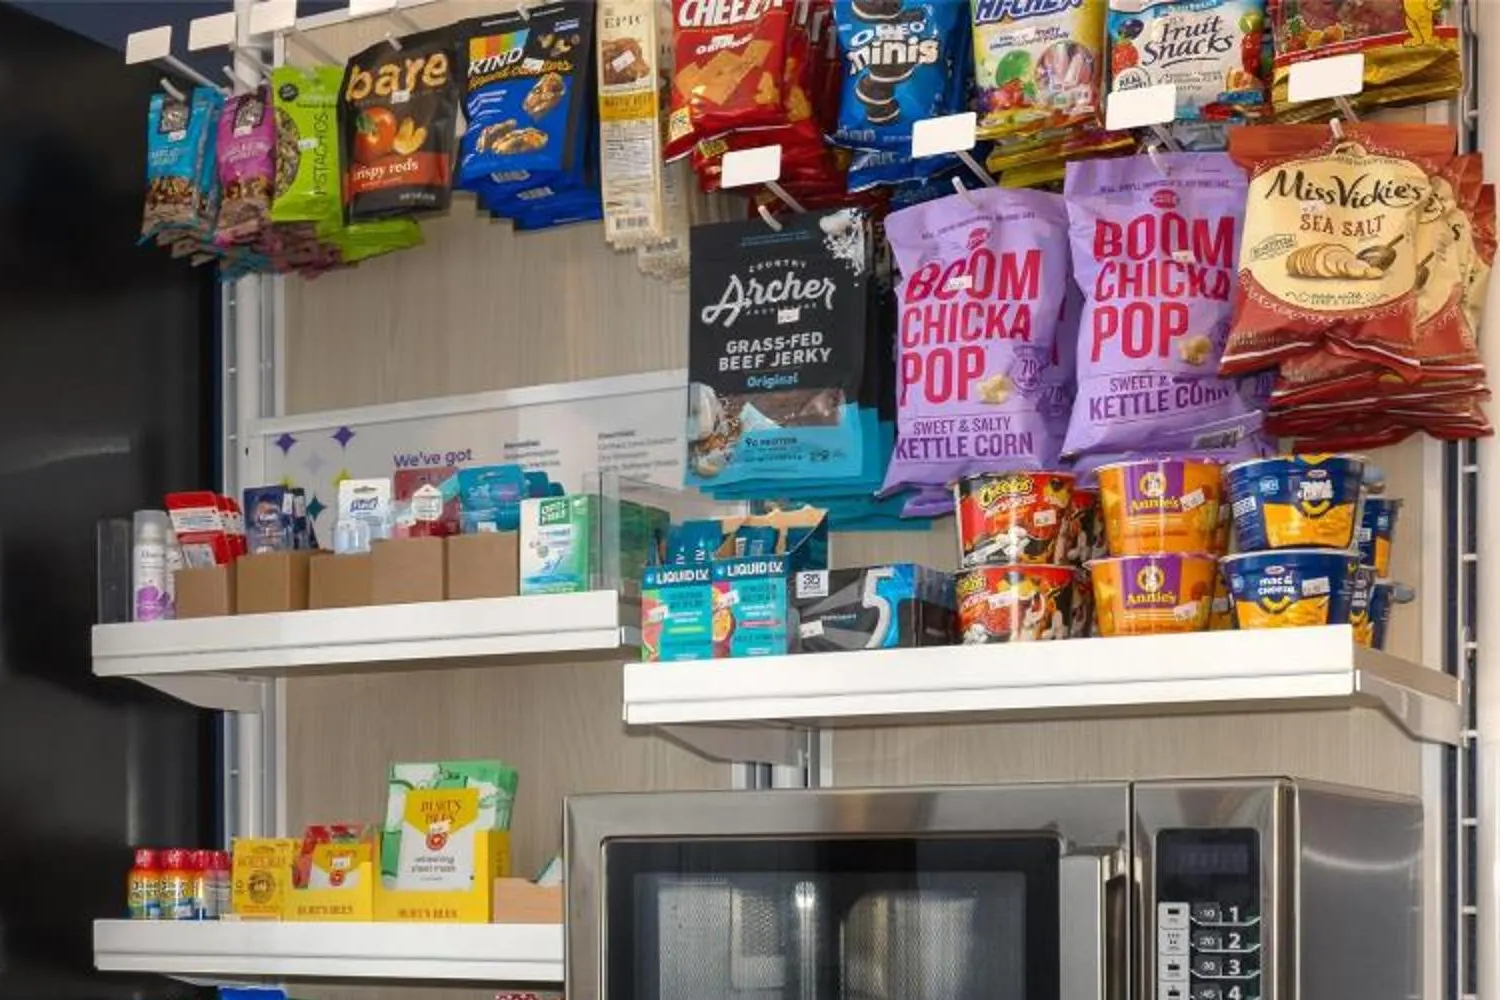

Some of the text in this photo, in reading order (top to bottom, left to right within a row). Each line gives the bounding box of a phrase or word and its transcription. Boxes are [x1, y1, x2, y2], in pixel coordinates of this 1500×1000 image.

[1159, 15, 1221, 45] Fruit
[467, 47, 524, 78] KIND
[846, 37, 940, 75] minis
[1142, 32, 1235, 67] Snacks
[346, 51, 449, 101] bare
[1265, 169, 1336, 203] Miss
[1330, 174, 1424, 209] Vickie's
[1300, 213, 1386, 237] SEA SALT
[1093, 211, 1236, 269] BOOM
[1095, 258, 1232, 302] CHICKA
[701, 271, 837, 328] Archer
[901, 301, 1032, 349] CHICKA
[1091, 300, 1190, 363] POP
[725, 331, 824, 355] GRASS-FED
[718, 347, 832, 372] BEEF JERKY
[747, 372, 799, 389] Original
[900, 345, 987, 407] POP
[1110, 375, 1154, 393] SWEET
[1089, 390, 1168, 421] KETTLE
[913, 416, 1013, 435] SWEET & SALTY
[393, 448, 473, 468] We've got
[896, 431, 1034, 460] KETTLE CORN
[1131, 496, 1180, 512] Annie's
[656, 570, 695, 585] LIQUID
[727, 561, 768, 578] LIQUID
[863, 566, 895, 650] 5
[1127, 590, 1177, 605] Annie's
[1229, 906, 1240, 923] 1
[1229, 933, 1242, 950] 2
[1229, 959, 1242, 976] 3
